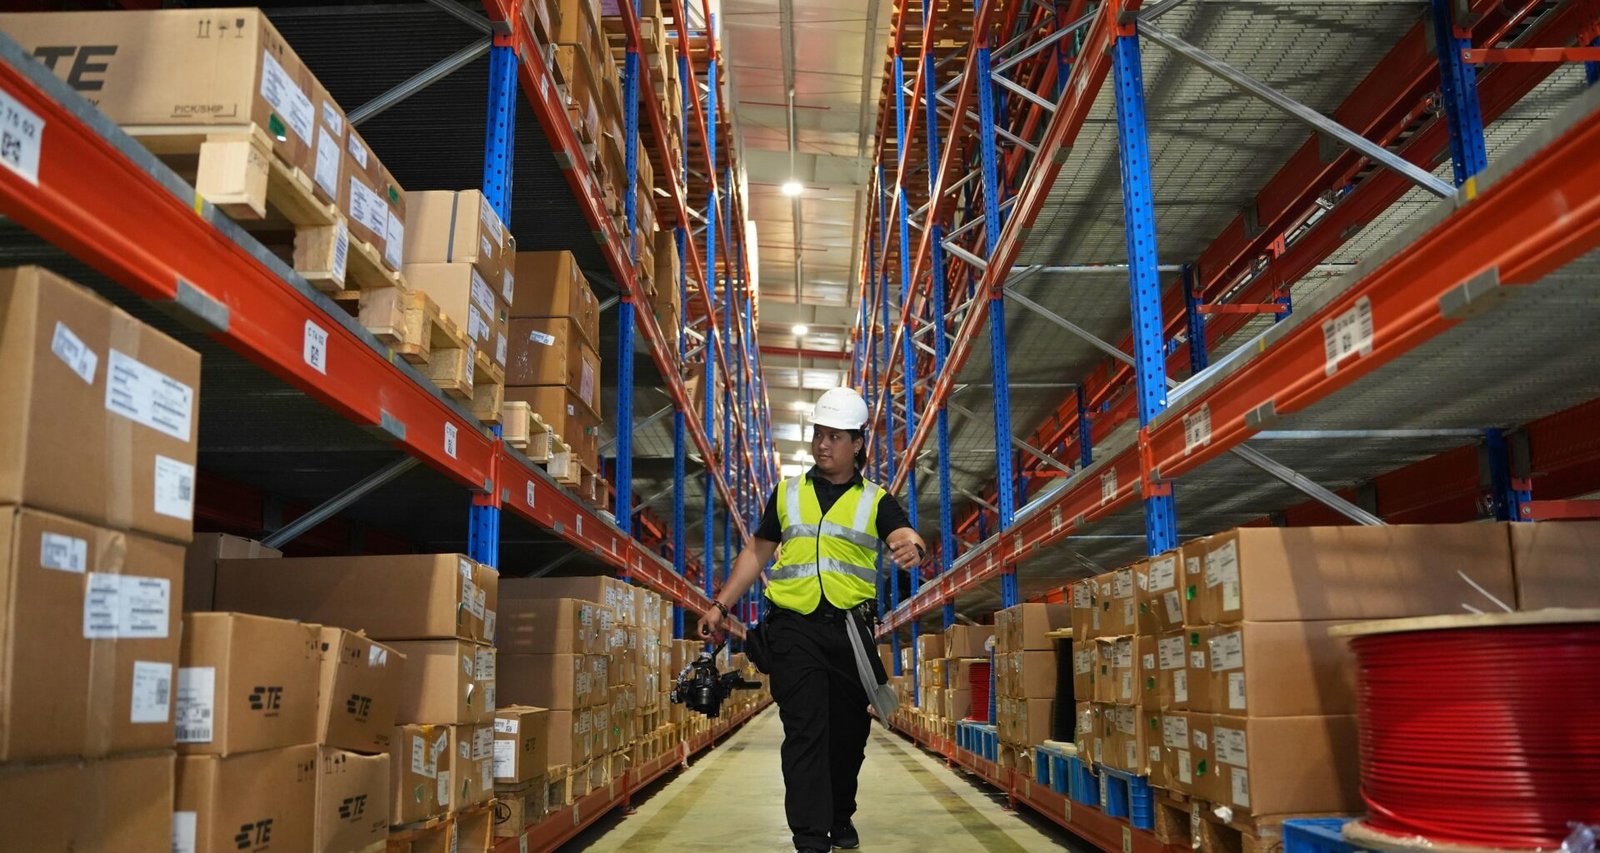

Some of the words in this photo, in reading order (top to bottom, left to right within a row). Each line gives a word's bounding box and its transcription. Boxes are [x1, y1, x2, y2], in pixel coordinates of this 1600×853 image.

[33, 46, 118, 91] TE
[175, 104, 223, 114] PICK/SHIP
[267, 686, 283, 710] TE
[358, 696, 372, 716] TE
[353, 794, 368, 817] TE
[255, 818, 273, 845] TE
